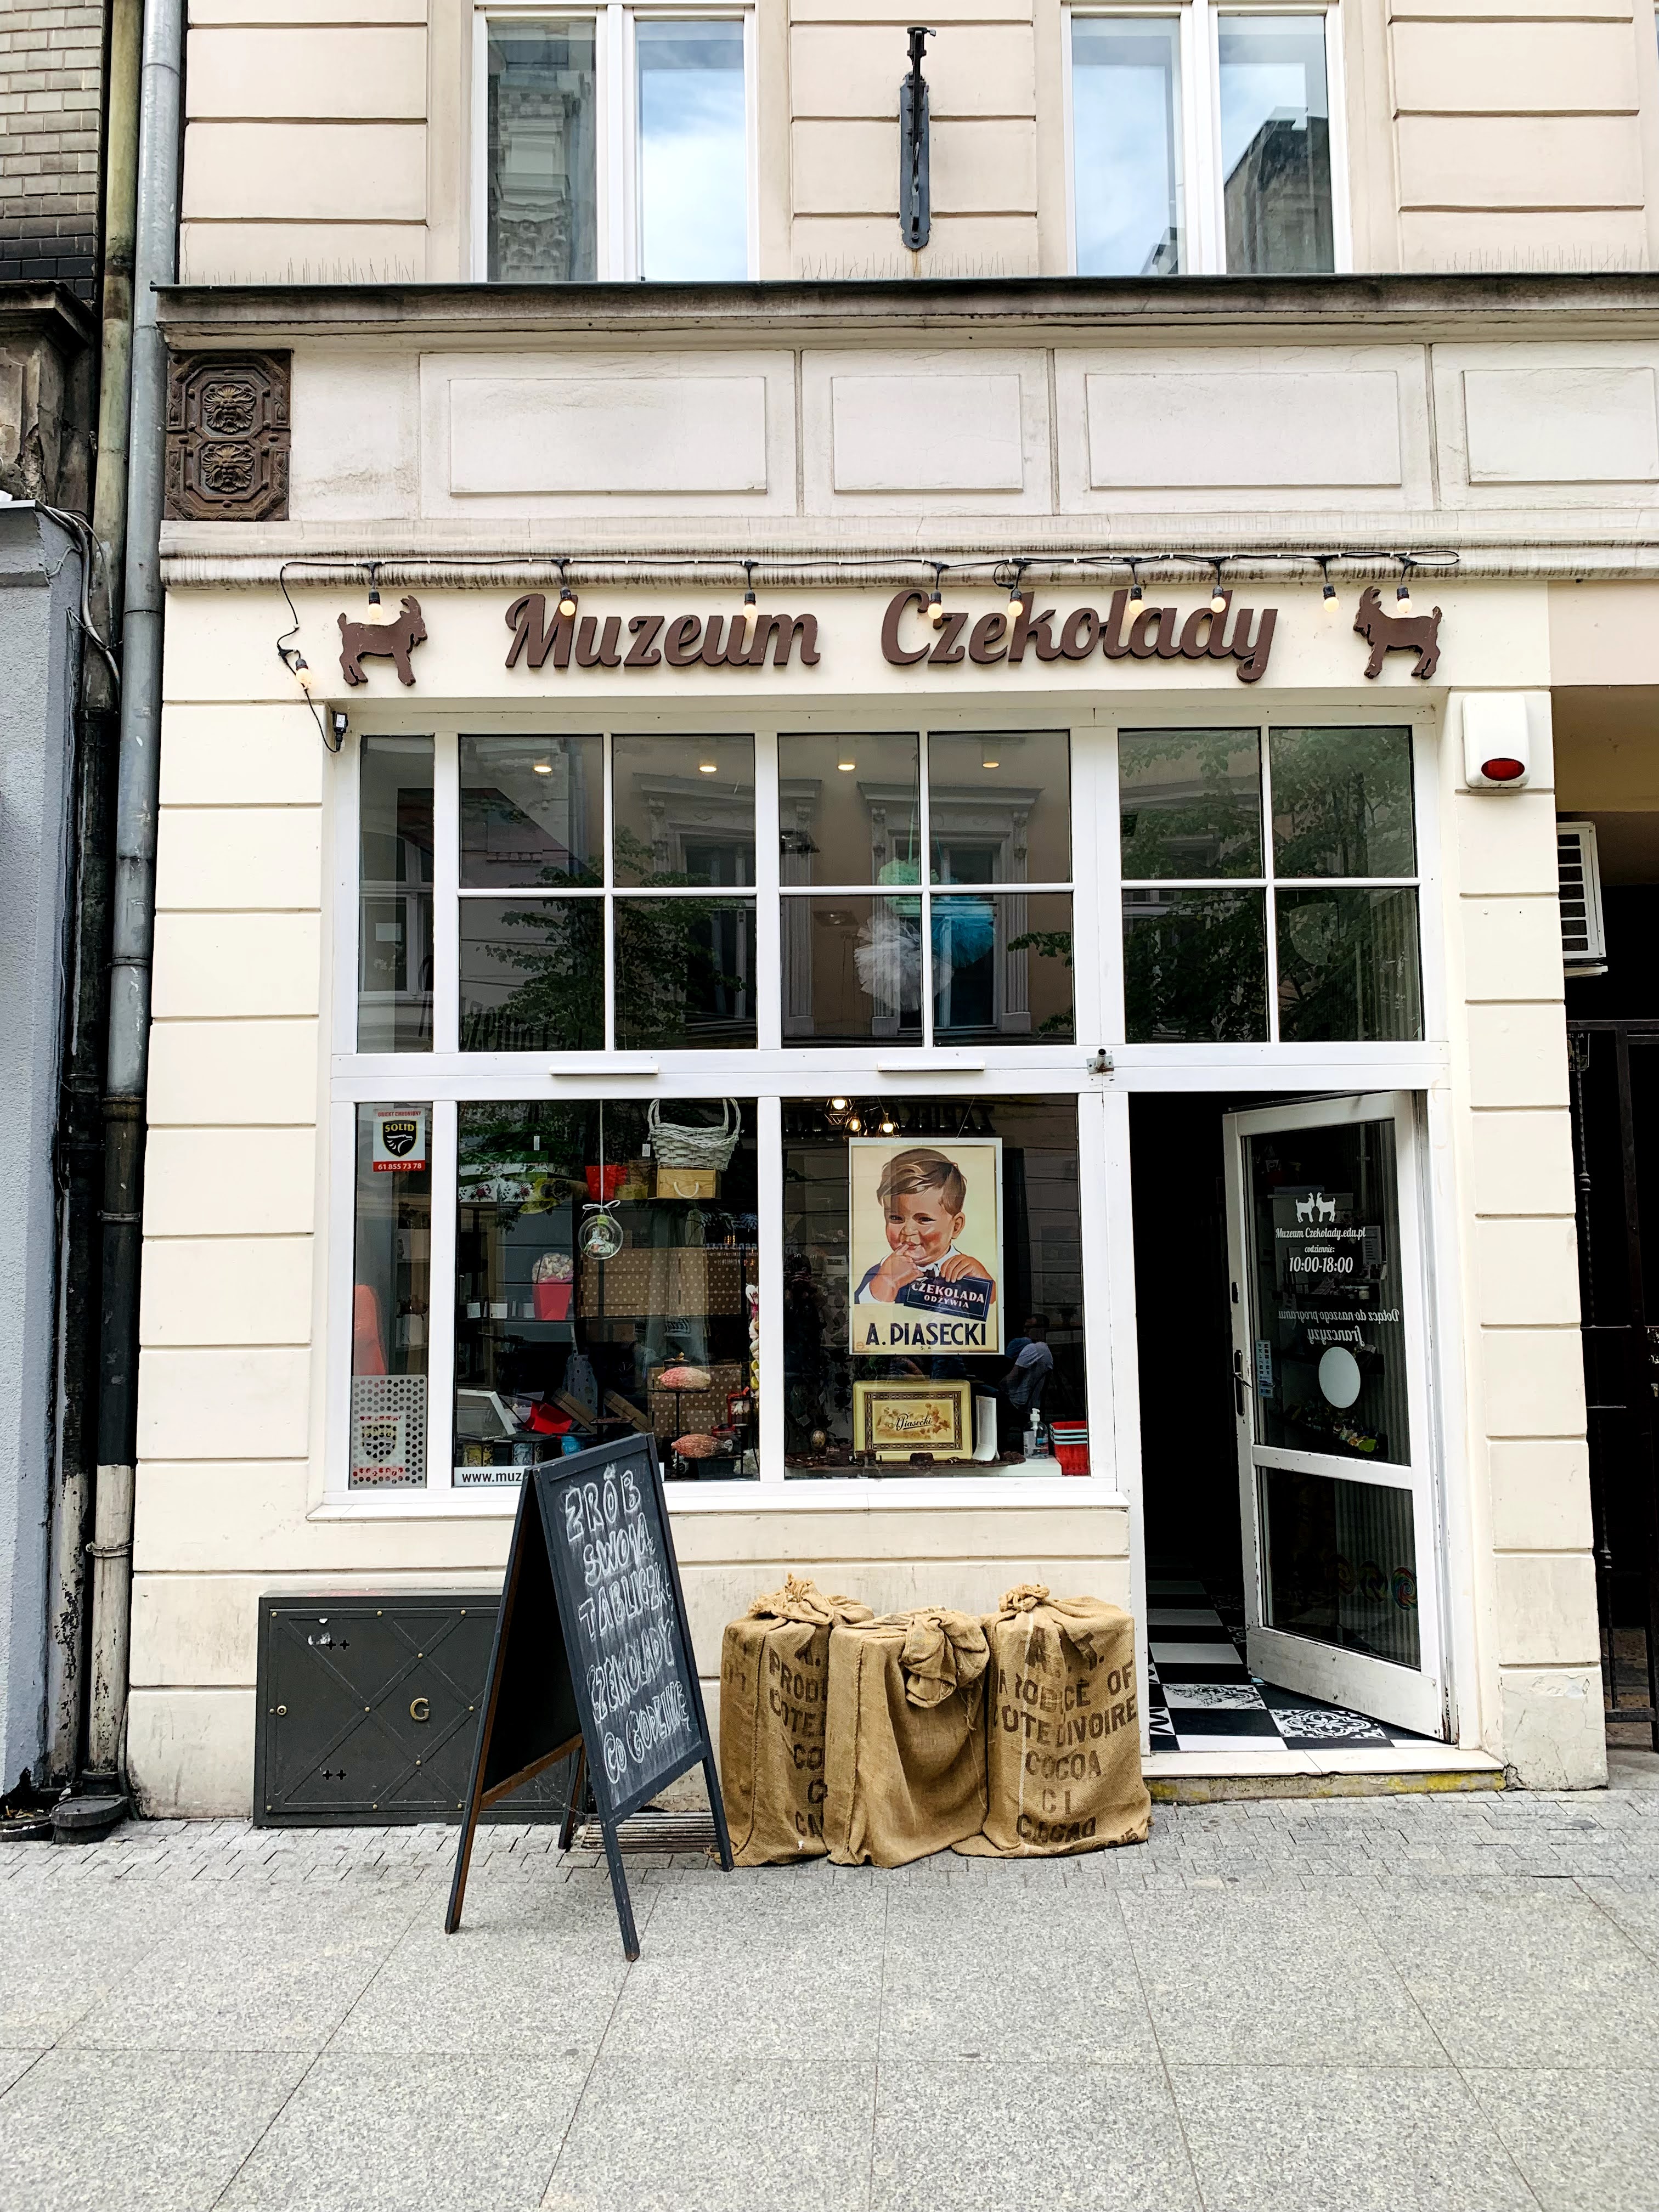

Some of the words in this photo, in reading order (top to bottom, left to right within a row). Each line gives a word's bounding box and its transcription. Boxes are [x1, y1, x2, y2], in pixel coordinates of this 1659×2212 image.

[505, 593, 820, 668] Muzeum
[881, 589, 1279, 683] Czekolady
[385, 1123, 414, 1132] SOLID
[1276, 1227, 1304, 1238] Muzeum
[1305, 1227, 1366, 1240] Czekolady.edu.pl
[1305, 1244, 1335, 1253] codziennie:
[1289, 1256, 1353, 1273] 10:00-18:00
[911, 1282, 984, 1303] CZEKOLADA
[924, 1295, 969, 1308] ODŻYWIA
[866, 1323, 886, 1345] A.
[890, 1323, 986, 1345] PIASECKI
[1107, 1659, 1133, 1696] OF
[410, 1697, 430, 1722] G
